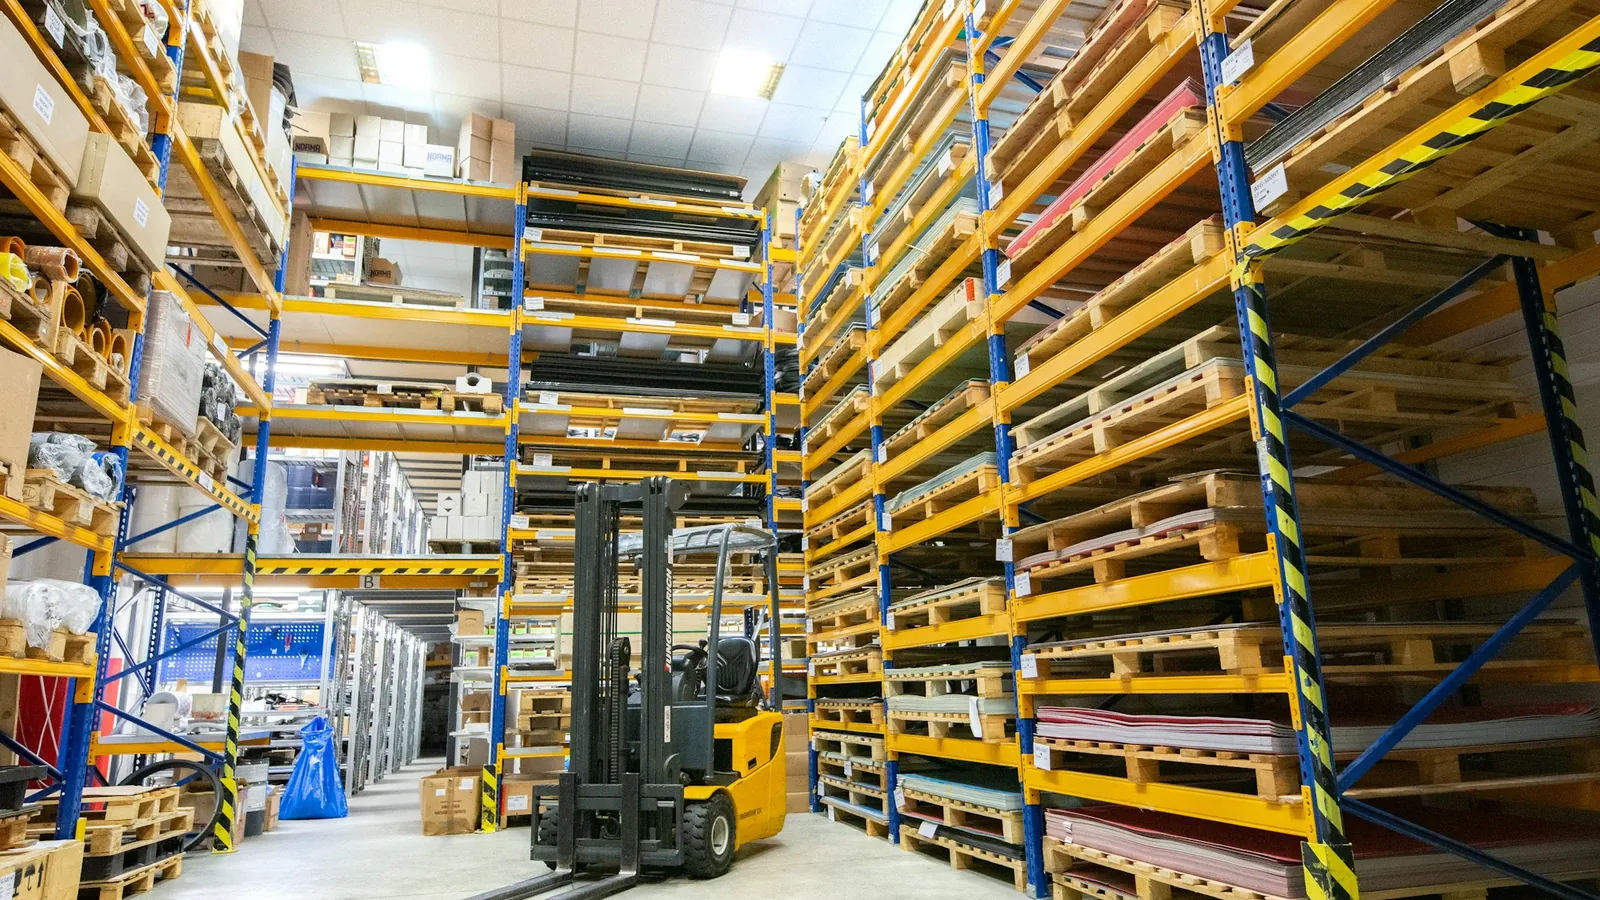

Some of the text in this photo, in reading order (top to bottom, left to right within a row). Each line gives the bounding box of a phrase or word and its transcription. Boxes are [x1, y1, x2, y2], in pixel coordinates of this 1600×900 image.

[295, 142, 321, 153] NORMA
[427, 151, 453, 164] NORMA
[369, 269, 392, 278] NORMA
[364, 575, 374, 589] B
[663, 567, 673, 673] JUNGHEINRICH
